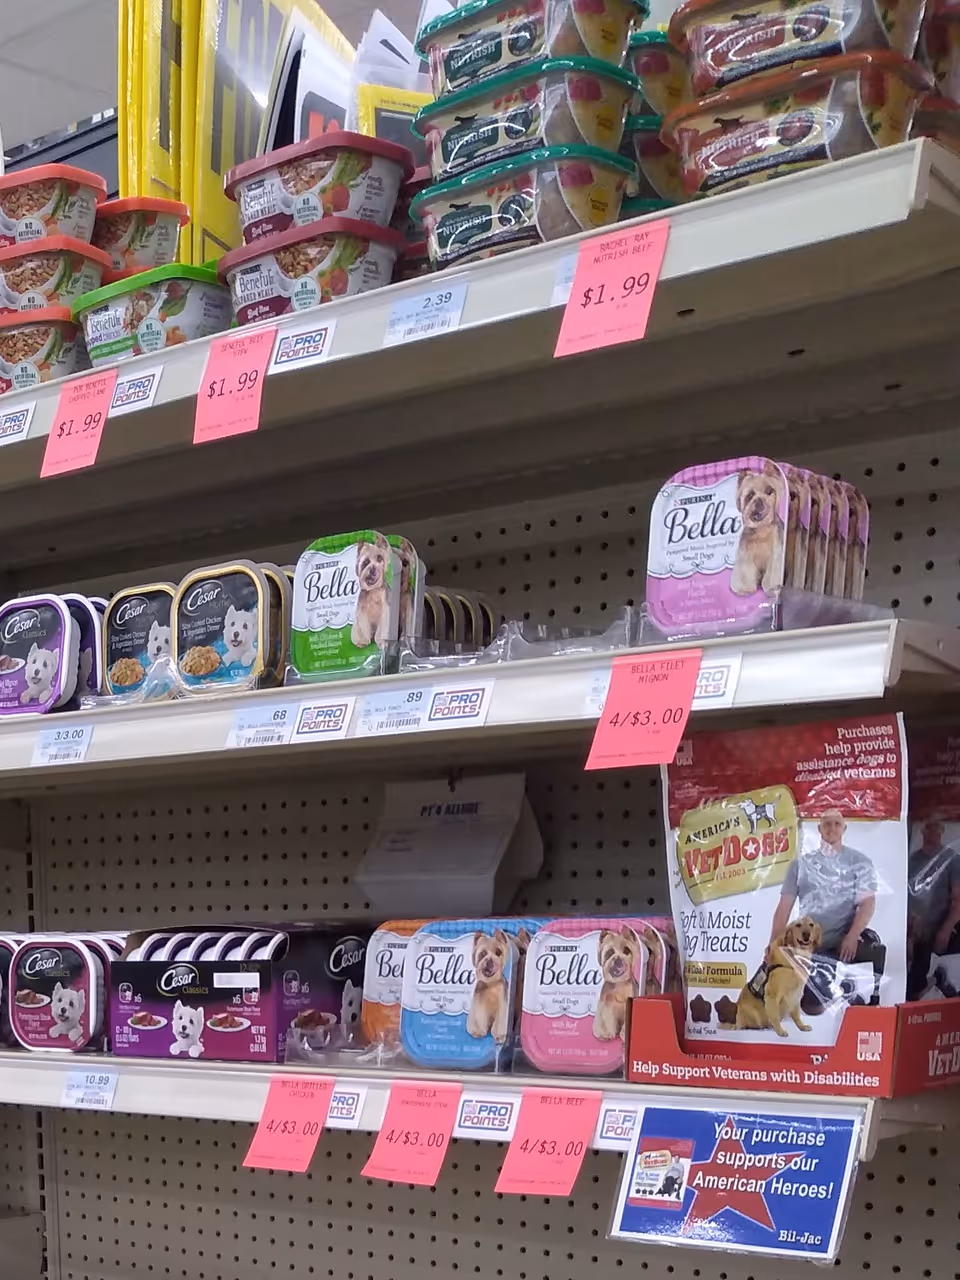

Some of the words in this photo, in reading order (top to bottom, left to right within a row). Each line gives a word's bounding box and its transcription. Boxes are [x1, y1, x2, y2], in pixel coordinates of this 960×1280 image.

[424, 292, 452, 308] 2.39
[580, 272, 650, 309] $1.99
[293, 333, 324, 350] PRO
[279, 345, 321, 361] POINTS
[127, 378, 151, 392] PRO
[207, 369, 258, 399] $1.99
[4, 413, 25, 425] PRO
[57, 411, 102, 438] $1.99
[664, 500, 741, 545] Bella
[303, 567, 359, 603] Bella
[187, 585, 222, 611] Cesar
[116, 602, 146, 624] Cesar
[5, 613, 37, 637] Cesar
[631, 662, 656, 674] BELLA
[659, 660, 685, 672] FILET
[638, 673, 669, 684] MIGNON
[450, 691, 481, 706] PRO
[315, 708, 342, 720] PRO
[433, 702, 480, 718] POINTS
[609, 707, 683, 728] 4/$3.00
[300, 718, 340, 731] POINTS
[837, 724, 893, 740] Purchases
[54, 729, 84, 741] 3/3.00
[825, 743, 851, 757] help
[853, 737, 896, 753] provide
[797, 755, 853, 770] assistance
[855, 754, 885, 768] dogs
[886, 752, 897, 764] to
[843, 765, 896, 779] veterans
[685, 816, 740, 845] AMERICA'S
[707, 909, 752, 929] Moist
[700, 930, 749, 953] Treats
[26, 953, 59, 974] Cesar
[415, 953, 476, 985] Bella
[536, 953, 602, 986] Bella
[706, 965, 743, 976] Formula
[161, 971, 195, 991] Cesar
[857, 1052, 880, 1062] USA
[85, 1076, 110, 1085] 10.99
[632, 1060, 659, 1076] Help
[662, 1063, 710, 1081] Support
[712, 1066, 767, 1081] Veterans
[770, 1068, 801, 1084] with
[804, 1070, 880, 1087] Disabilities
[478, 1104, 508, 1117] PRO
[265, 1119, 319, 1137] 4/$3.00
[463, 1115, 507, 1128] POINTS
[386, 1129, 445, 1149] 4/$3.00
[713, 1121, 749, 1141] Your
[751, 1127, 826, 1148] purchase
[520, 1138, 583, 1158] 4/$3.00
[717, 1148, 786, 1173] supports
[790, 1156, 819, 1172] our
[693, 1171, 766, 1193] American
[770, 1178, 834, 1200] Heroes!
[778, 1229, 822, 1245] Bil-Jac
